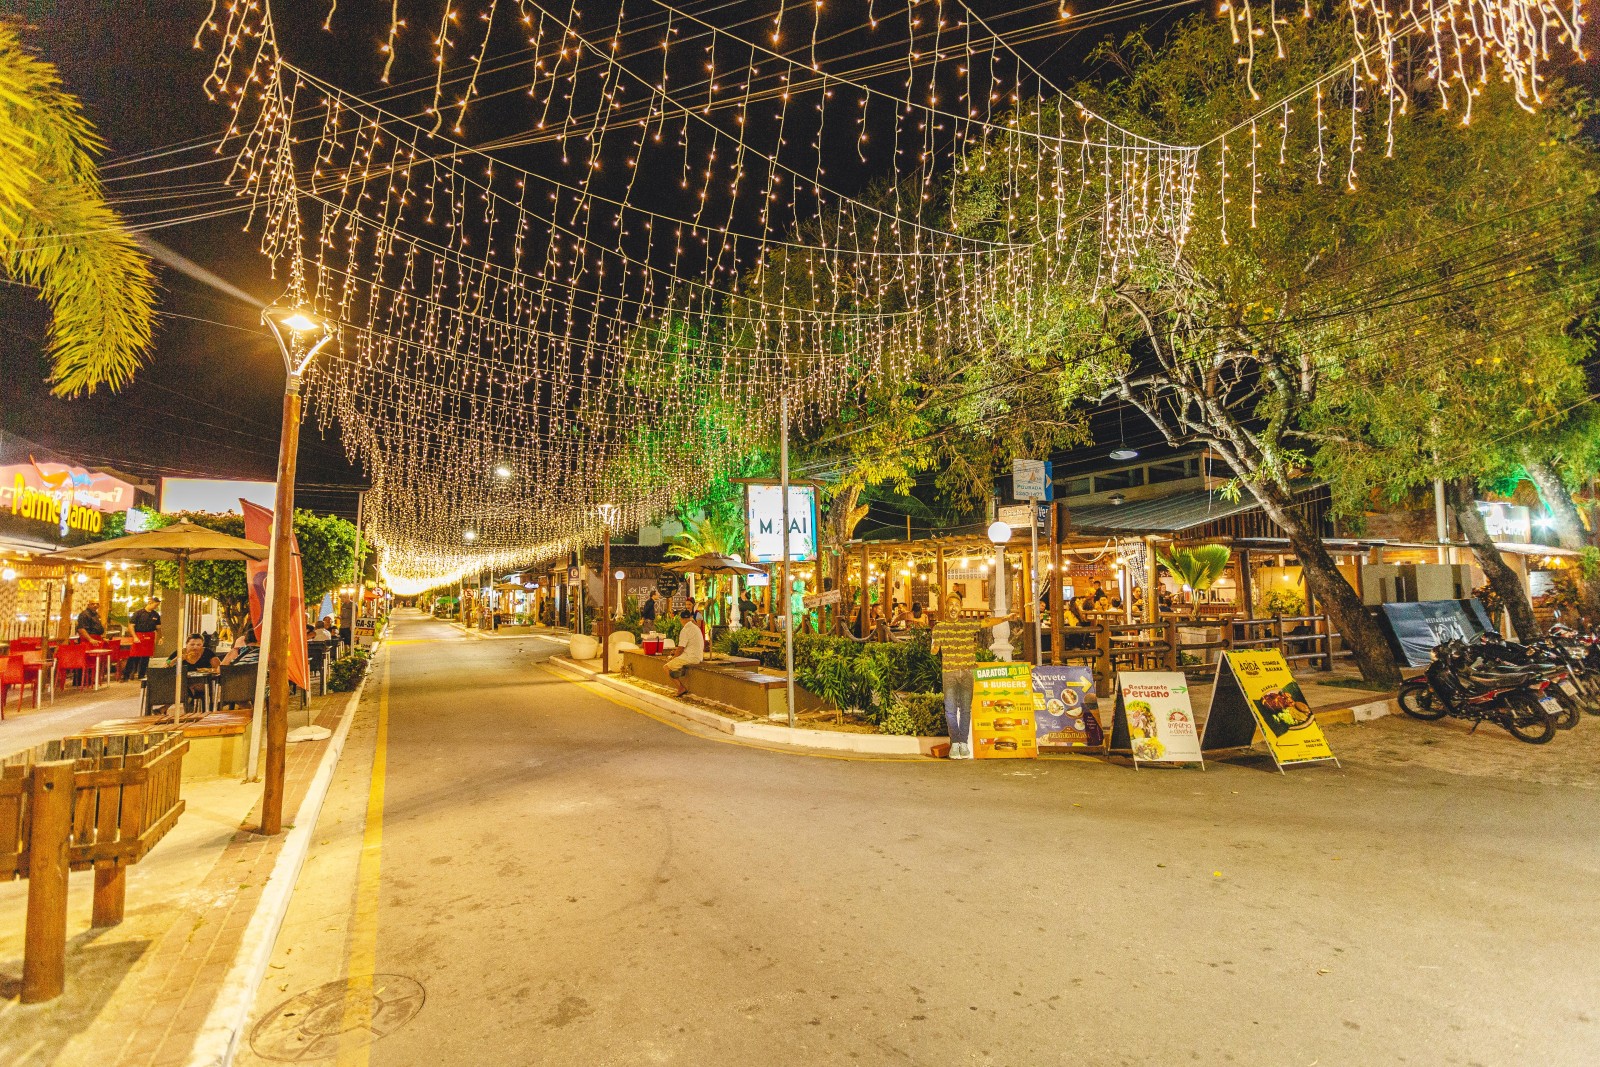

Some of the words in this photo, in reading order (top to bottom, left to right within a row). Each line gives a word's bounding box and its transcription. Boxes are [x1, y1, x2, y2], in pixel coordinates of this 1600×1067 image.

[11, 472, 101, 537] Parmegianno
[355, 619, 375, 628] GA-SE
[1018, 666, 1030, 675] DIA
[1032, 672, 1066, 681] Sorvete
[1122, 688, 1170, 698] Peruano
